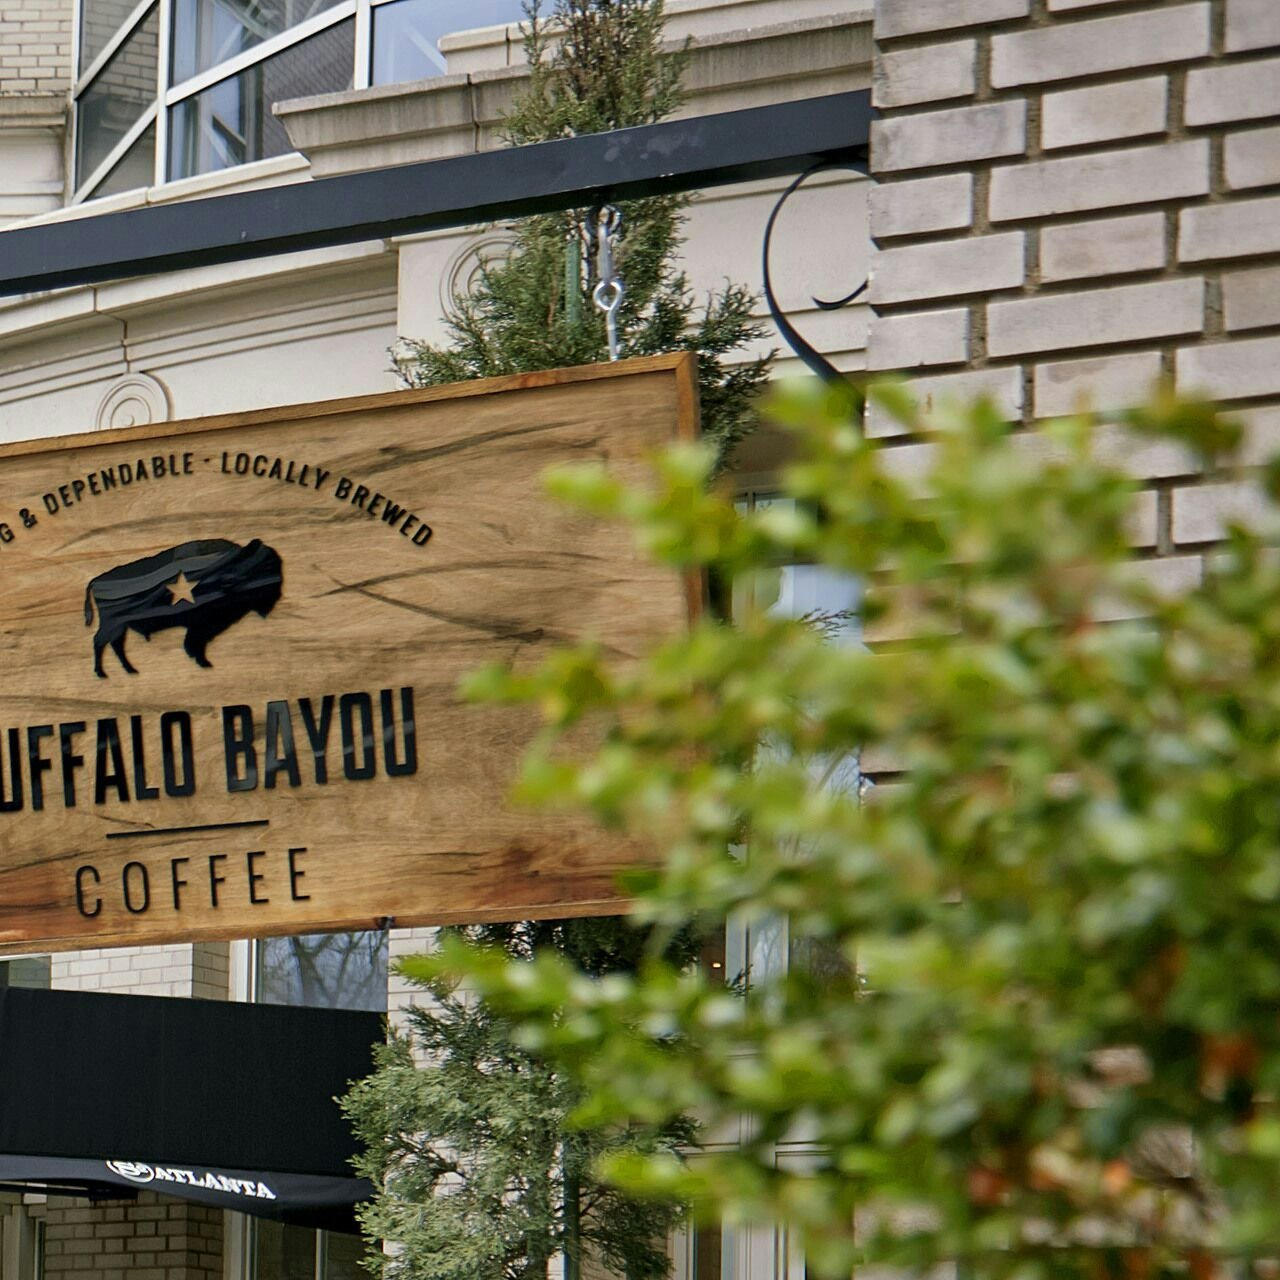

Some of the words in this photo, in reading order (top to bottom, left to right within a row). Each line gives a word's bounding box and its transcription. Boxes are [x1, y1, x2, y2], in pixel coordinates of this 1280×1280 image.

[19, 507, 38, 529] &
[42, 452, 195, 516] DEPENDABLE
[220, 451, 330, 491] LOCALLY
[334, 476, 434, 547] BREWED
[221, 686, 418, 794] BAYOU
[74, 847, 312, 918] COFFEE
[153, 1166, 277, 1200] ATLANTA
